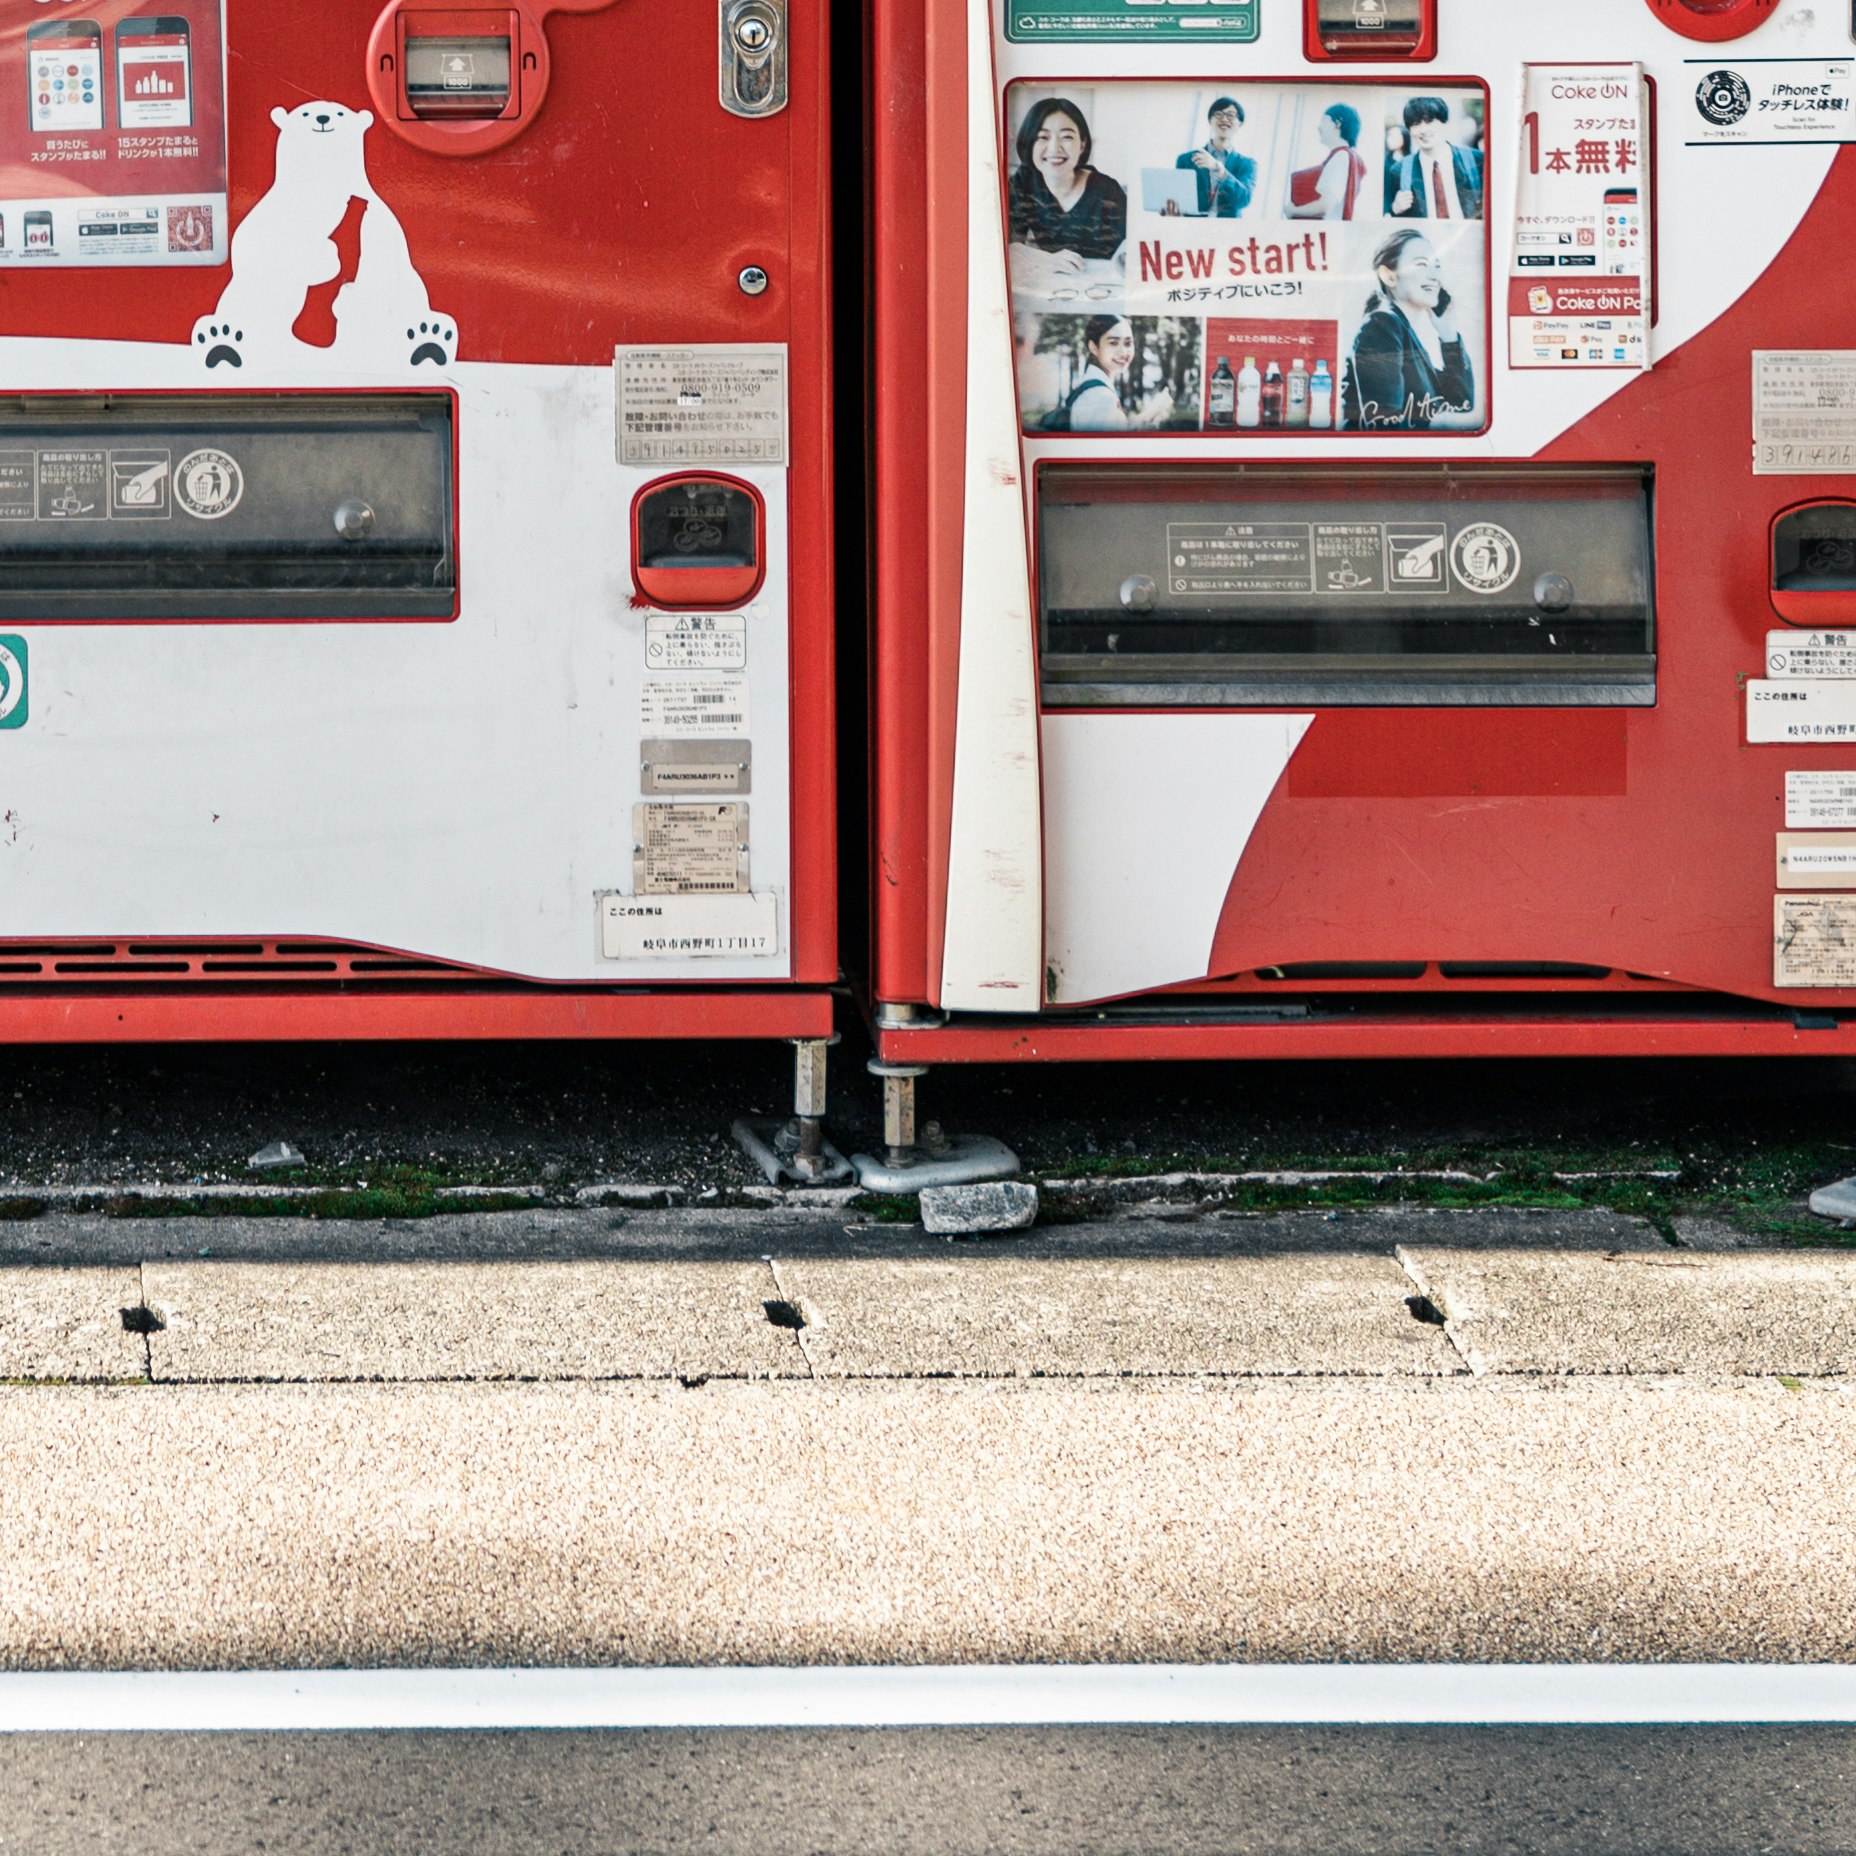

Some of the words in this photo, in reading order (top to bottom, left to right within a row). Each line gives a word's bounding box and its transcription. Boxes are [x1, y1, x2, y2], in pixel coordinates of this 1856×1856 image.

[1552, 84, 1596, 99] Coke
[1758, 98, 1849, 112] タッチレス体験!
[117, 136, 198, 147] 15スタンプたまると
[1139, 240, 1214, 281] New
[1229, 232, 1329, 277] start!
[1167, 281, 1303, 302] ポジティブにいこう!
[1228, 334, 1314, 345] あなたの時間とご一緒に
[43, 454, 102, 462] 商品の取り出し方
[185, 497, 233, 514] リサイクル
[691, 618, 715, 631] 警告
[1755, 693, 1807, 701] ここの住所は
[610, 908, 662, 916] ここの住所は
[644, 938, 766, 950] 岐阜市西野町1丁目17
